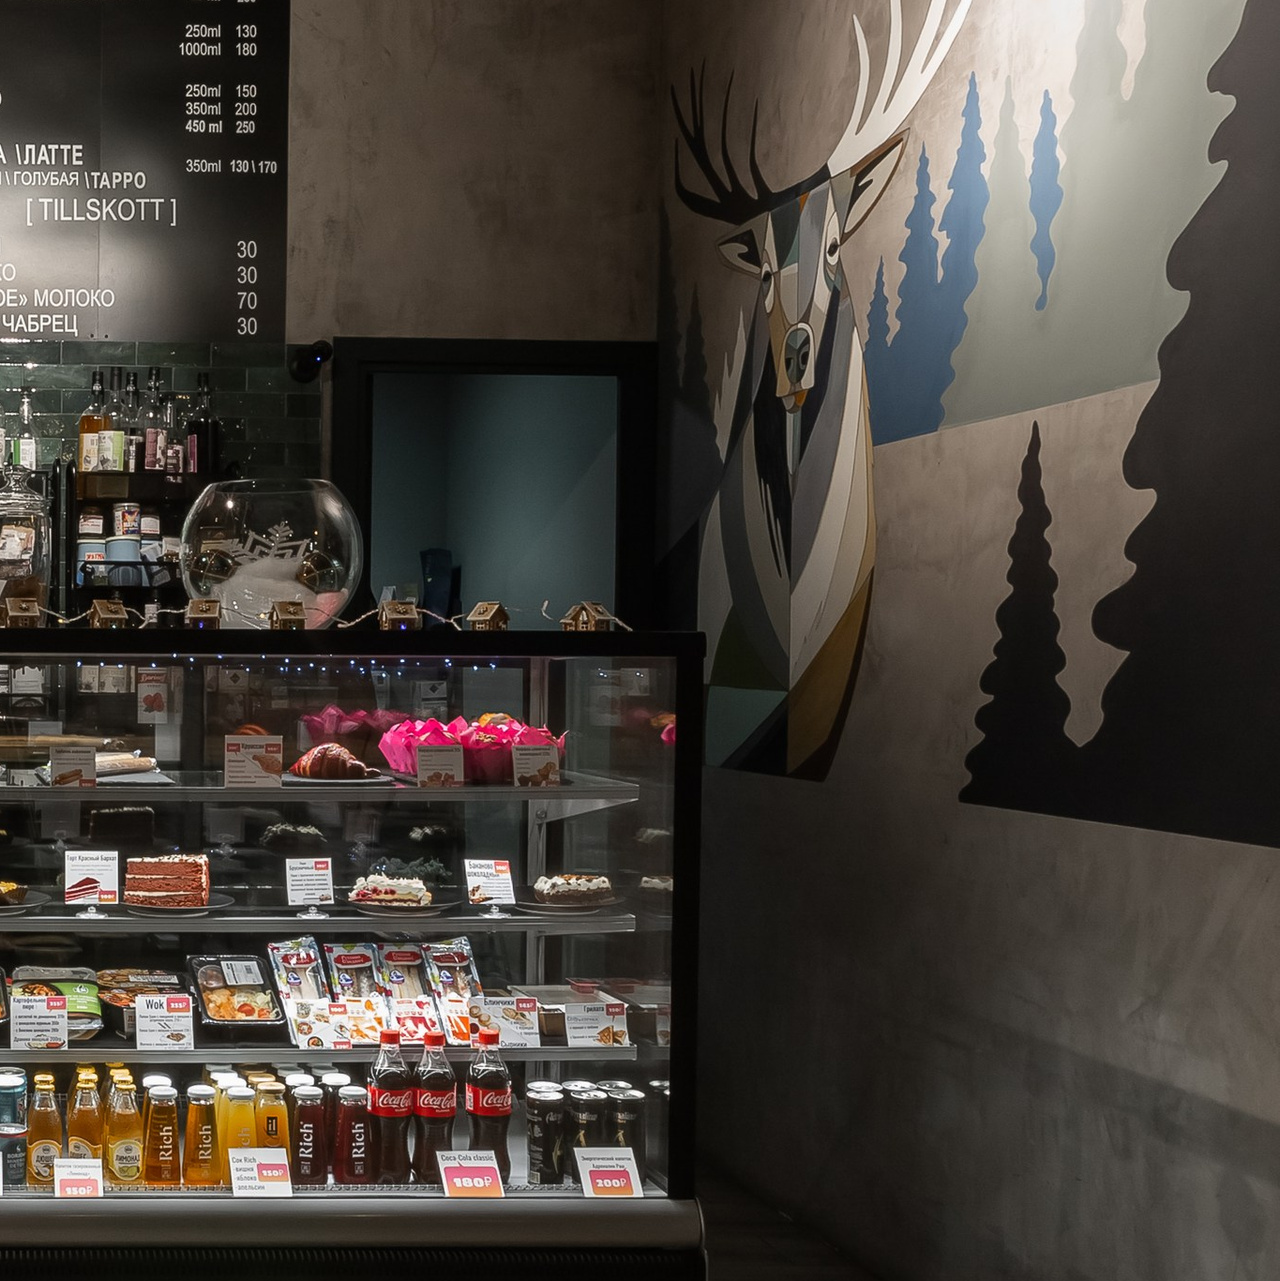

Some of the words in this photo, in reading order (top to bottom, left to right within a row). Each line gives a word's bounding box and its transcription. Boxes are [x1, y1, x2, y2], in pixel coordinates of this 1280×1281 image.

[185, 25, 221, 38] 250ml
[236, 25, 257, 38] 130
[179, 43, 221, 56] 1000ml
[236, 43, 257, 56] 180
[185, 85, 221, 98] 250ml
[236, 85, 257, 98] 150
[185, 103, 221, 115] 350ml
[235, 103, 257, 115] 200
[185, 121, 205, 133] 450
[209, 121, 222, 133] ml
[236, 122, 255, 134] 250
[186, 160, 221, 173] 350ml
[14, 172, 78, 186] ГОЛУБАЯ
[39, 199, 164, 221] TILLSKOTT
[237, 241, 257, 258] 30
[237, 266, 257, 284] 30
[34, 289, 115, 307] МОЛОКО
[238, 292, 257, 309] 70
[2, 315, 78, 336] ЧАБРЕЦ
[237, 318, 257, 335] 30
[145, 999, 164, 1010] Wok
[159, 1125, 173, 1161] Rich
[199, 1124, 212, 1160] Rich
[299, 1121, 314, 1158] Rich
[352, 1121, 365, 1158] Rich
[473, 1154, 494, 1162] classic
